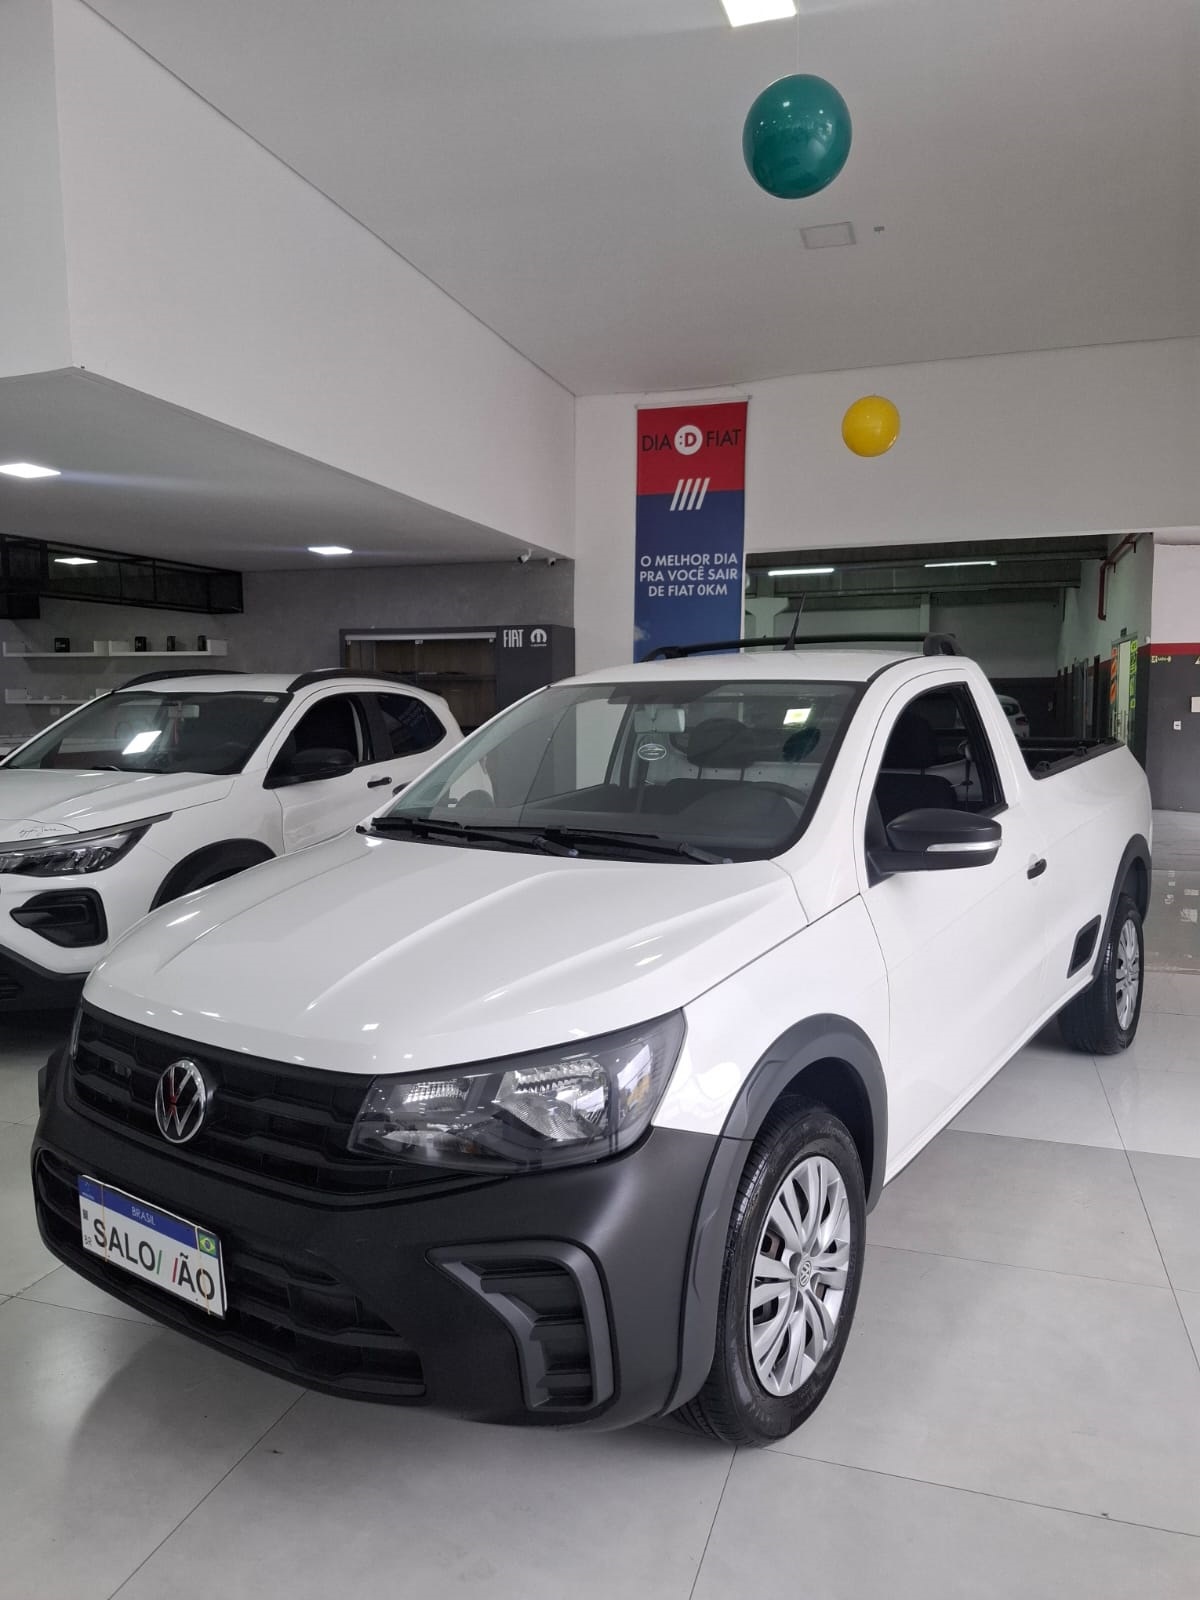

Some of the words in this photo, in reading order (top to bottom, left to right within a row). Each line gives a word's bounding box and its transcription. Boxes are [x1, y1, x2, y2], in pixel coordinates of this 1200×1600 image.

[642, 433, 673, 452] DIA
[706, 429, 742, 448] FIAT
[640, 555, 652, 568] O
[655, 553, 710, 567] MELHOR
[714, 552, 738, 566] DIA
[639, 570, 664, 583] PRA
[667, 565, 705, 582] VOCÊ
[708, 568, 738, 581] SAIR
[648, 585, 665, 598] DE
[668, 584, 695, 597] FIAT
[503, 629, 525, 648] FIAT
[131, 1206, 156, 1226] BRASIL
